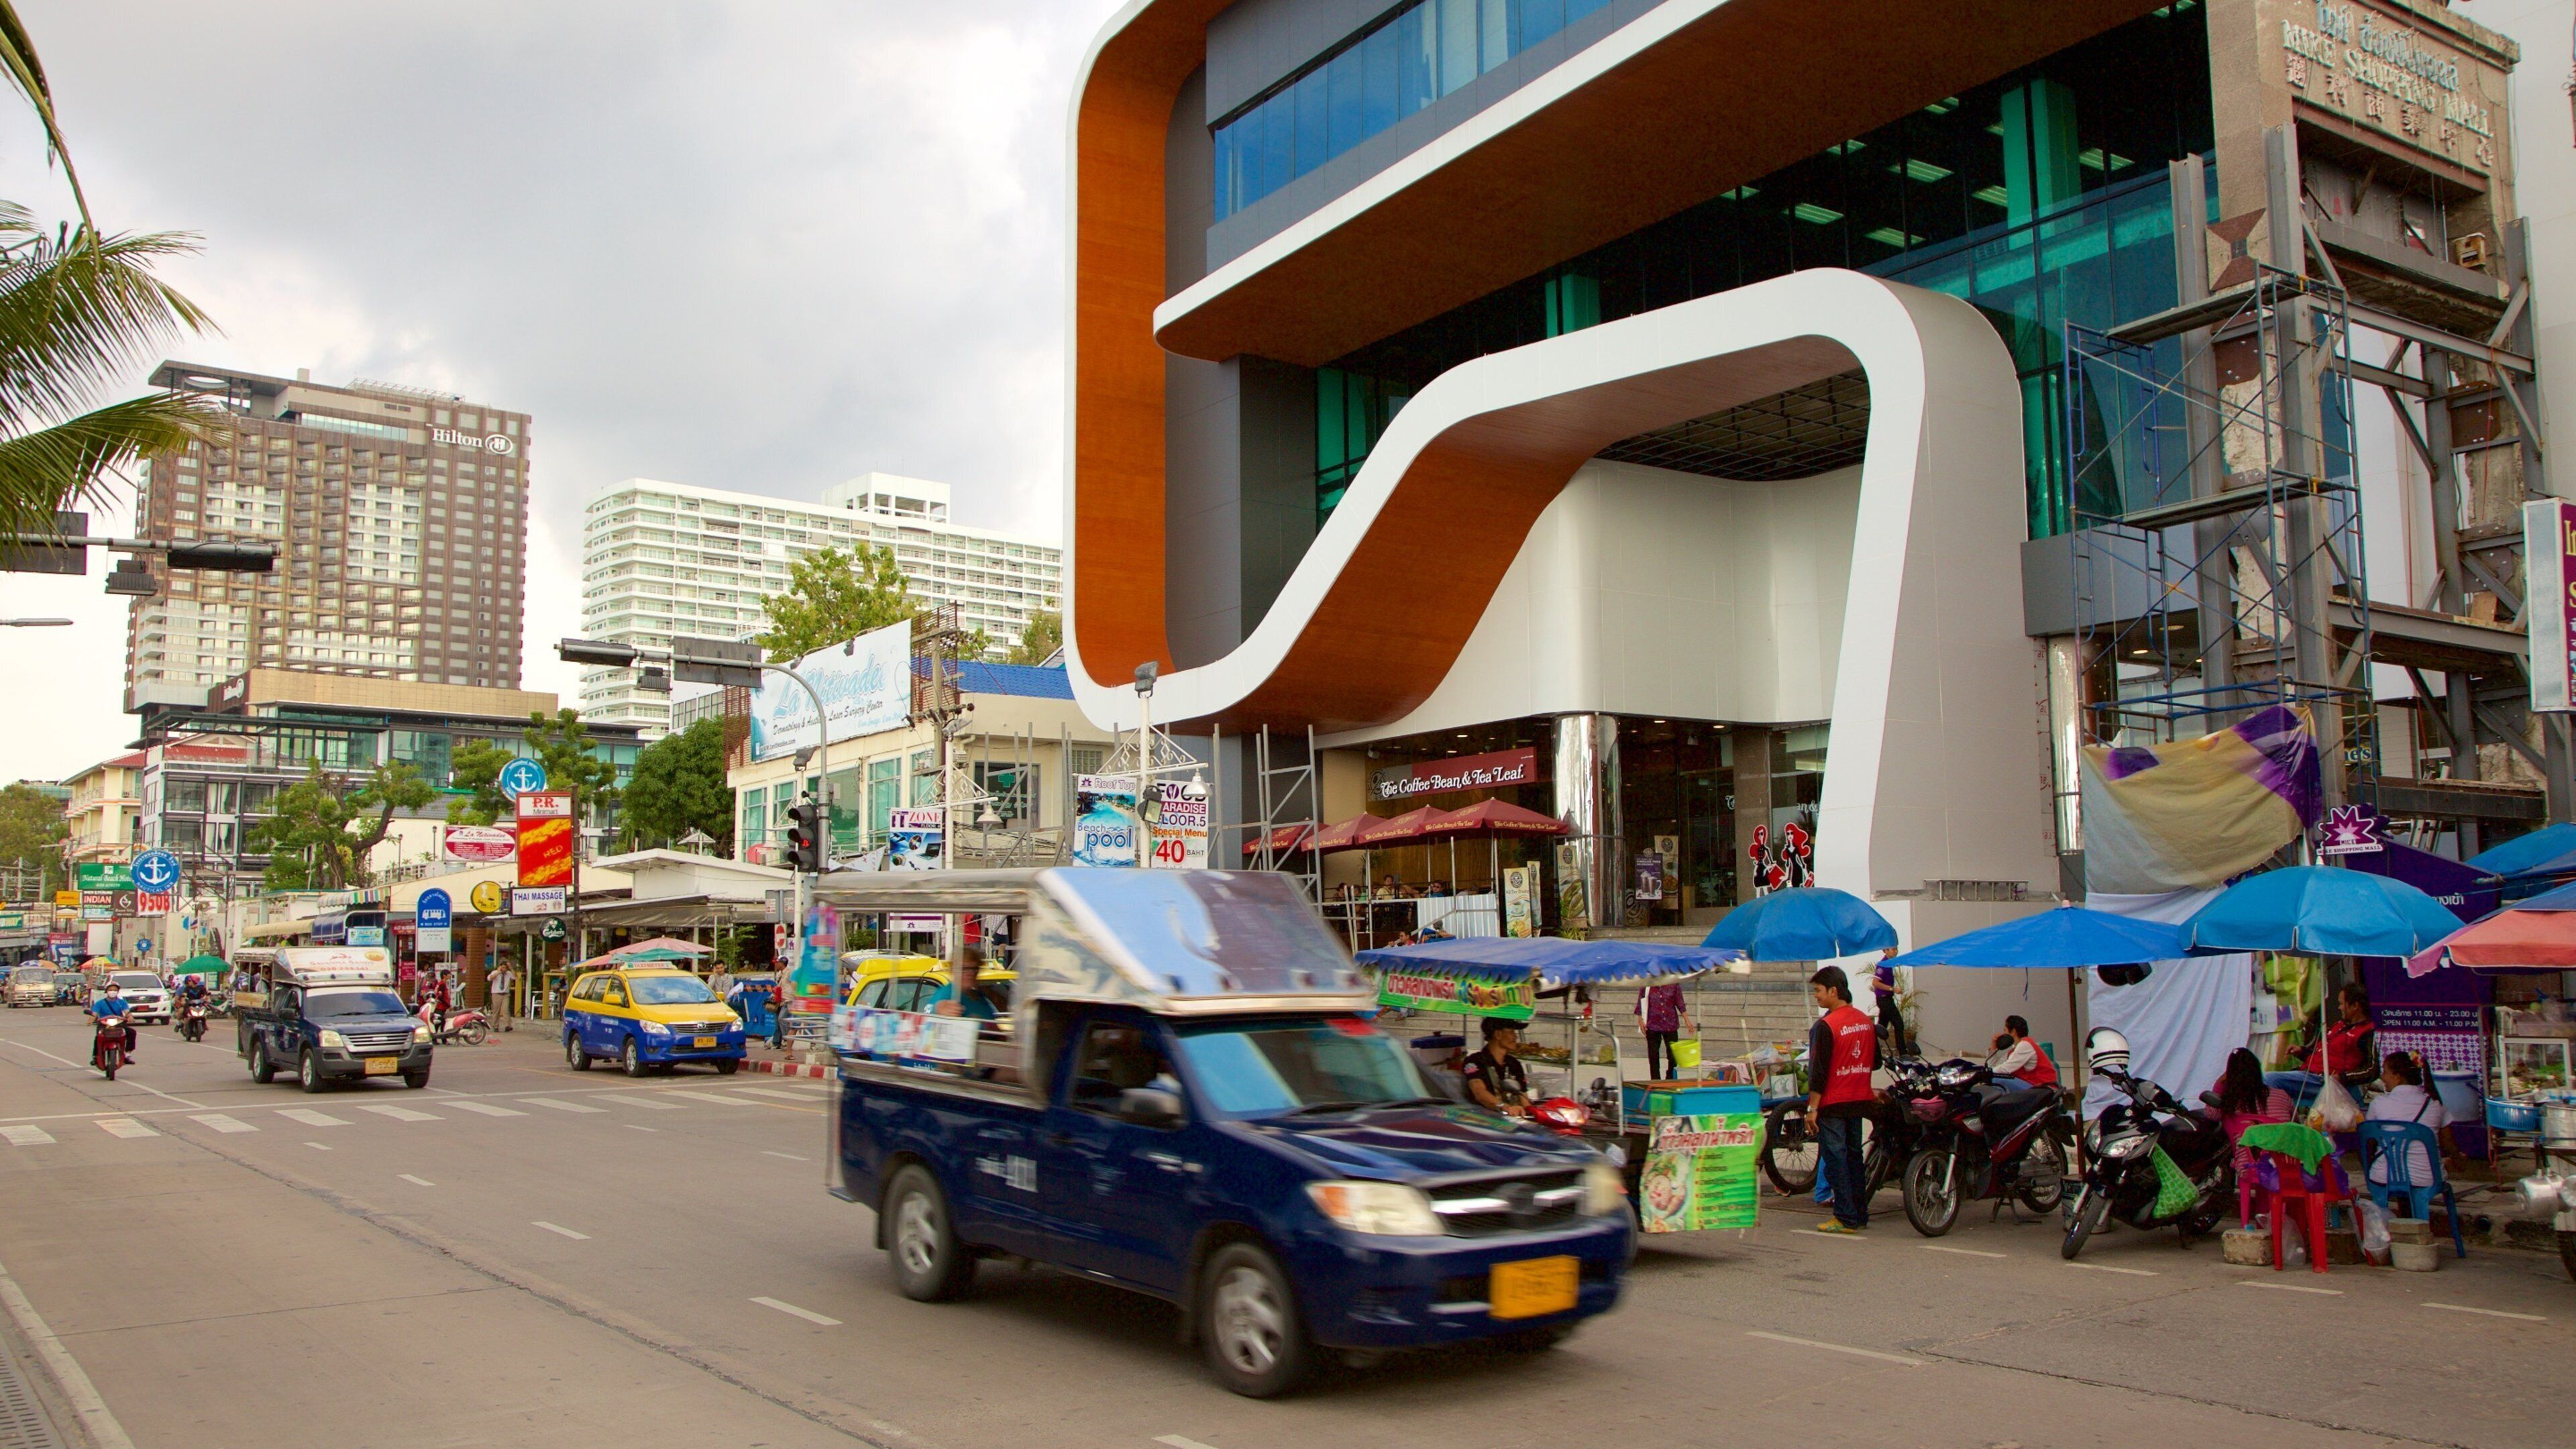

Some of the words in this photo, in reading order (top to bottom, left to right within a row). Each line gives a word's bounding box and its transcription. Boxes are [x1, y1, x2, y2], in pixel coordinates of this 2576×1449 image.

[431, 428, 483, 448] Hilton
[772, 676, 801, 720] La
[1094, 777, 1117, 789] Roof
[1118, 780, 1136, 792] Top
[1381, 781, 1397, 798] The
[1399, 777, 1430, 794] Coffee
[1430, 774, 1462, 789] Bean
[1462, 771, 1472, 786] &
[1472, 768, 1492, 784] Tea
[532, 797, 559, 808] P.R.
[1161, 801, 1206, 814] ARADISE
[1077, 820, 1106, 832] Beach
[1152, 826, 1182, 837] Special
[1185, 828, 1208, 838] Menu
[1085, 826, 1133, 853] pool
[543, 845, 564, 858] RED
[1155, 839, 1185, 864] 40
[136, 881, 164, 893] NAUTICAL
[164, 881, 174, 890] INN
[83, 896, 111, 904] INDIAN
[514, 893, 529, 901] THAI
[531, 892, 563, 900] MASSAGE
[1852, 1040, 1861, 1059] 4
